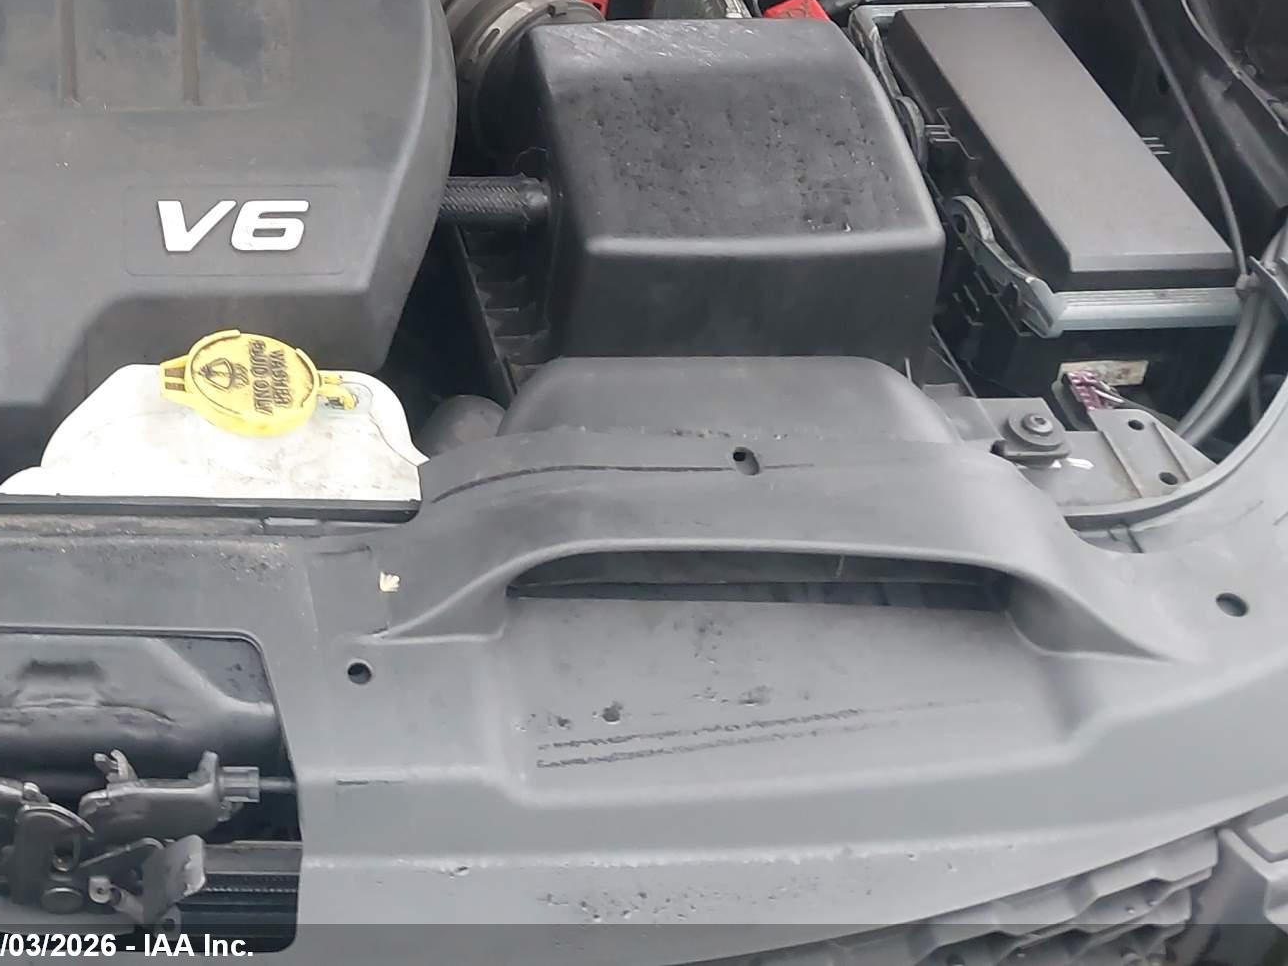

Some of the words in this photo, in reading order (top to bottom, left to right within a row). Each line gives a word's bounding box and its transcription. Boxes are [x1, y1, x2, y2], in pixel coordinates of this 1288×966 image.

[157, 199, 310, 252] V6
[249, 339, 268, 377] FLUID
[269, 349, 292, 408] WASHER
[253, 380, 274, 416] ONLY
